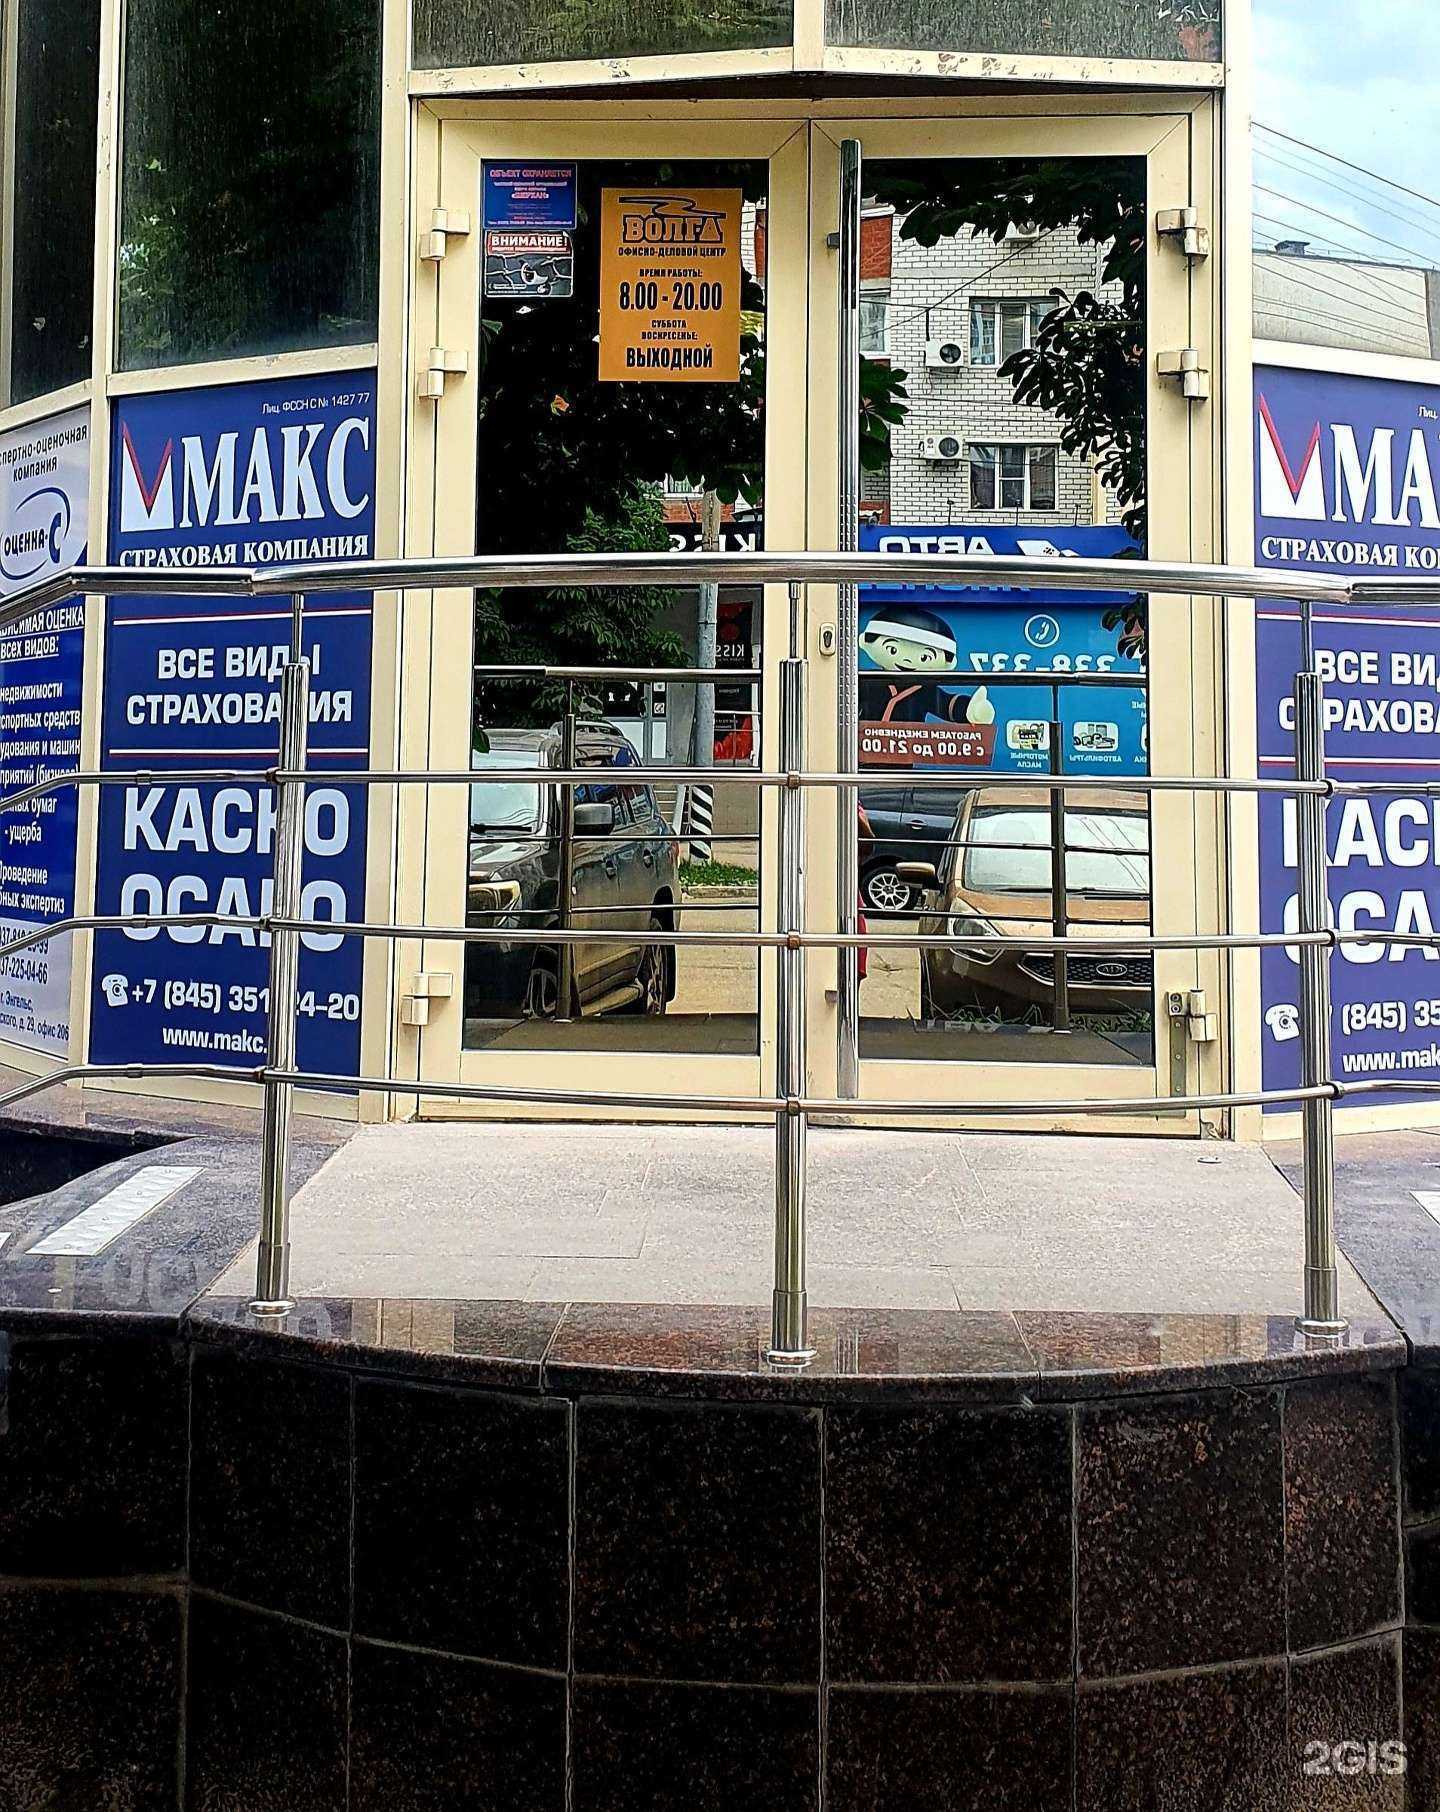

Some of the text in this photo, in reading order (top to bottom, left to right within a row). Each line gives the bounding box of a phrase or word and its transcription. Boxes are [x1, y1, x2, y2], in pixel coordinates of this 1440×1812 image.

[491, 236, 568, 247] ВНИМАНИЕ!
[623, 214, 724, 244] ВОЛГА
[618, 245, 727, 258] ОФИСНО-ДЕЛОВОЙ ЦЕНТР
[640, 268, 703, 278] ВРЕМЯ РАБОТЫ:
[619, 281, 658, 311] 8.00
[672, 281, 723, 311] 20.00
[641, 331, 698, 341] ВОСКРЕСЕНЬЕ:
[651, 319, 687, 328] СУББОТА
[626, 342, 713, 371] ВЫХОДНОЙ
[13, 456, 58, 482] компания
[179, 416, 371, 529] МАКС
[119, 534, 370, 568] СТРАХОВАЯ КОМПАНИЯ
[1260, 536, 1440, 571] СТРАХОВАЯ КО
[46, 605, 84, 630] ОЦЕНКА
[24, 635, 60, 658] видов:
[158, 647, 214, 679] ВСЕ
[1314, 649, 1440, 694] ВСЕ ВИ
[0, 682, 63, 704] недвижимости
[43, 710, 81, 732] средств
[126, 691, 353, 725] СТРАХОВАИЯ
[1278, 695, 1440, 733] СРАХОВ
[49, 739, 81, 756] машин
[9, 820, 42, 844] ущерба
[21, 890, 65, 915] экспертиз
[132, 979, 360, 1021] +7 (845) 3514-20
[37, 1019, 56, 1039] офис
[1342, 1001, 1407, 1036] (845)
[162, 1027, 268, 1054] www.makc.
